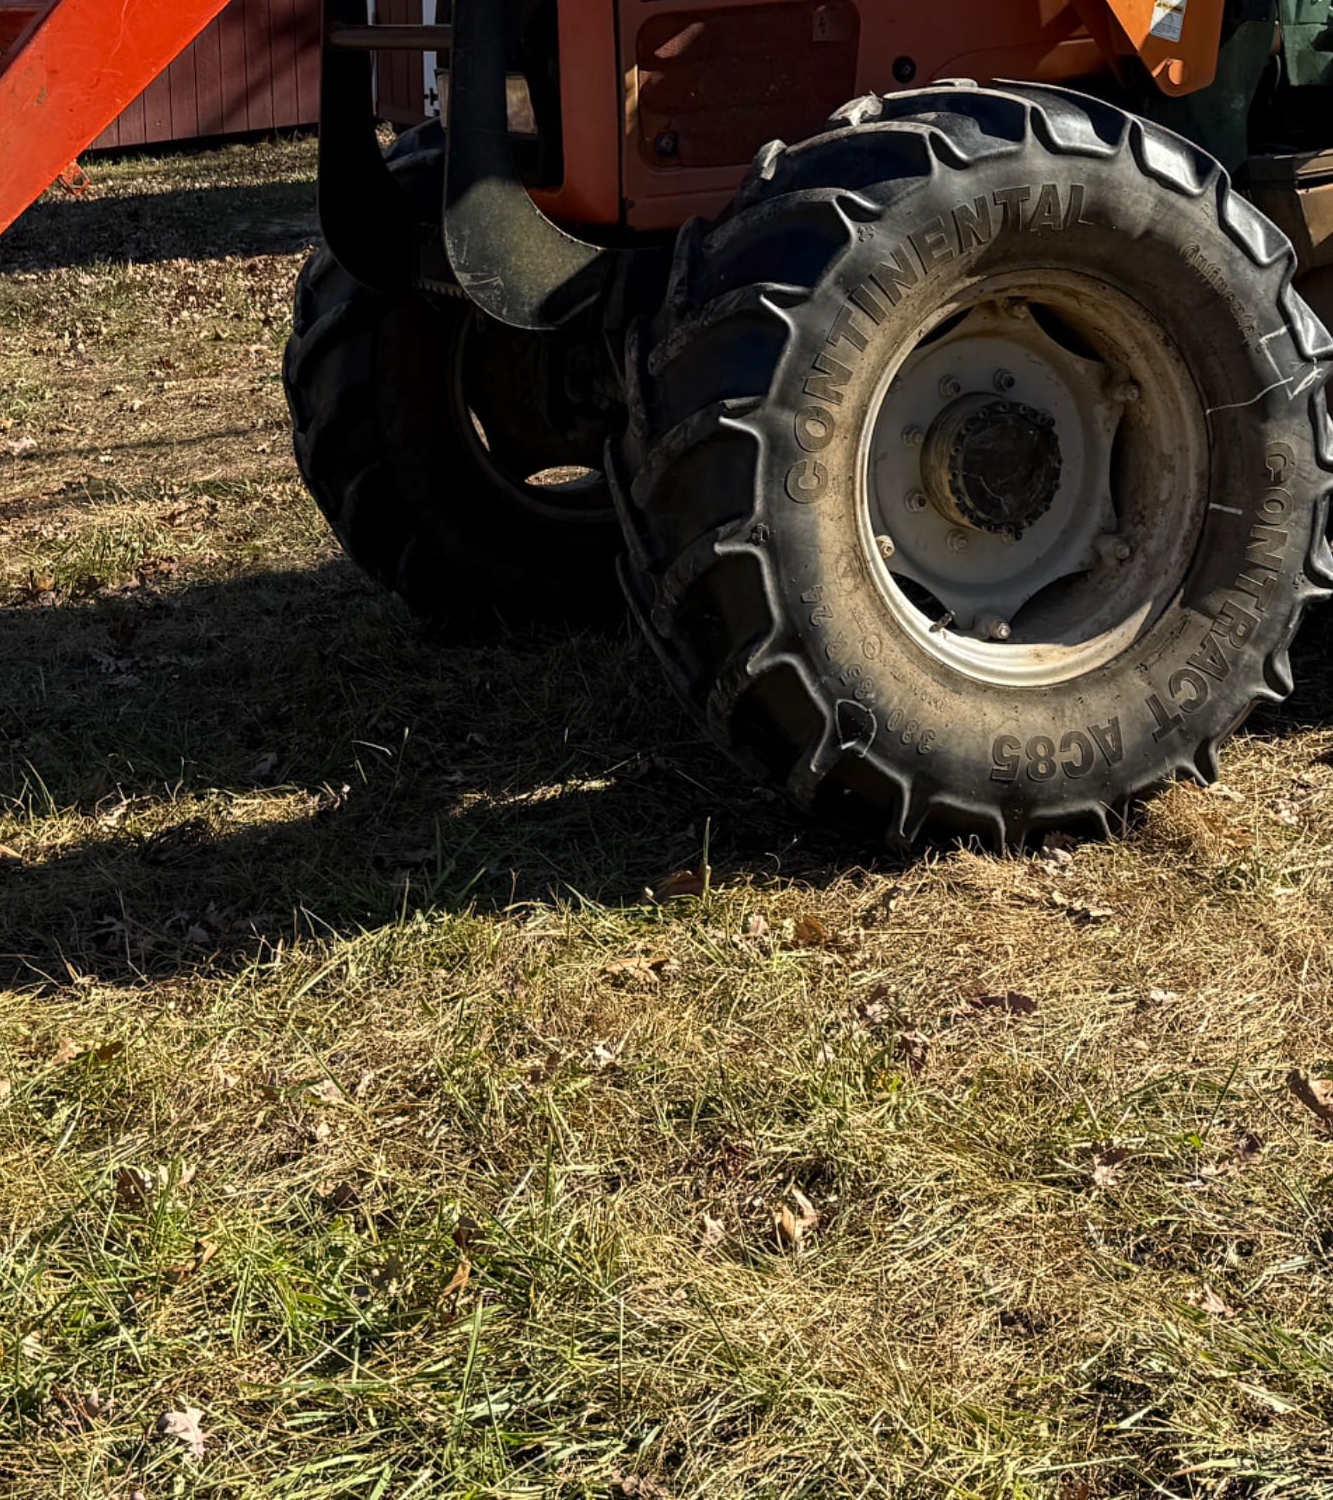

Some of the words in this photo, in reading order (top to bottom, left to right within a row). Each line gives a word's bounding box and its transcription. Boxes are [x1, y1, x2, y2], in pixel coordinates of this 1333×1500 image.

[785, 182, 1094, 505] CONTINENTAL
[1144, 440, 1297, 744] CONTRACT
[988, 715, 1125, 784] AC85
